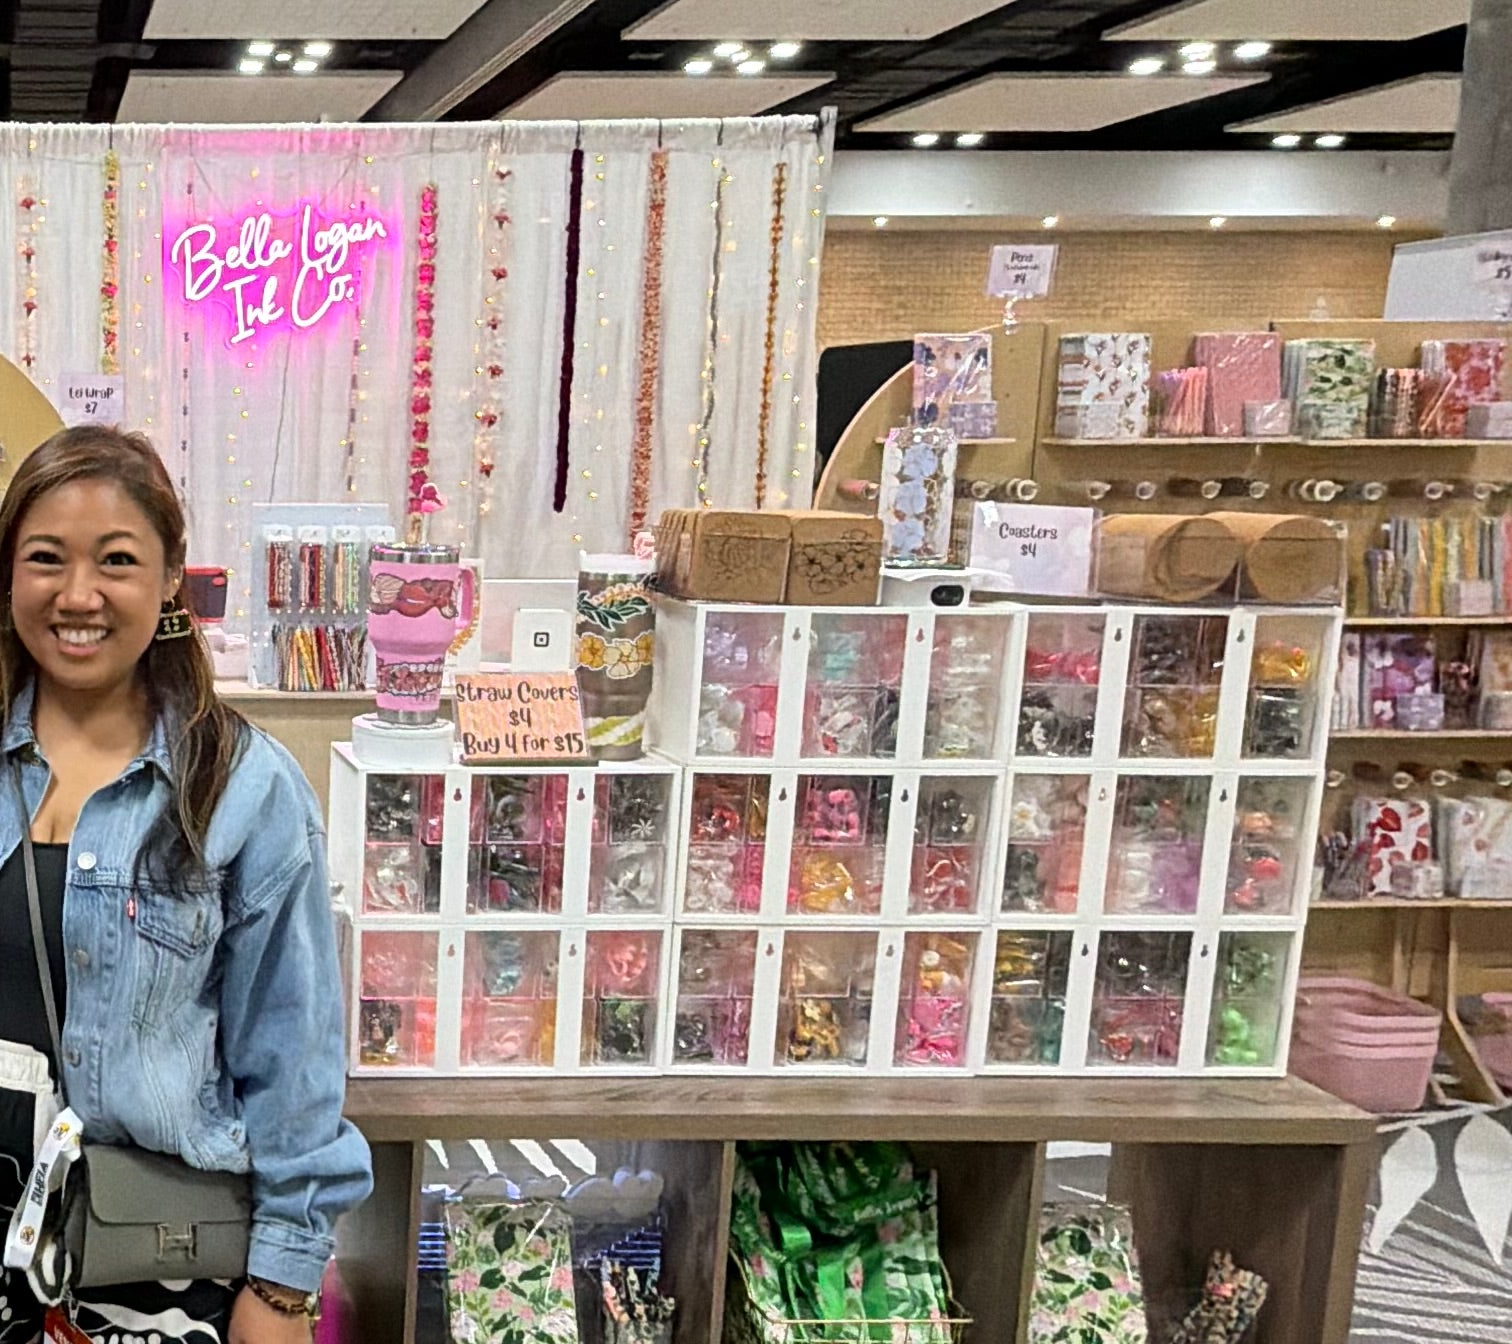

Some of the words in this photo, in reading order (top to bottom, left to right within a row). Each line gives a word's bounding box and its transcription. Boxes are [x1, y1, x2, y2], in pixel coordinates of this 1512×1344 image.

[171, 213, 293, 301] Bella
[301, 204, 387, 274] Logan
[223, 275, 285, 344] Ink
[291, 260, 355, 328] Co.
[999, 522, 1058, 540] Coasters
[1020, 543, 1037, 558] $4
[455, 682, 512, 703] Straw
[517, 681, 579, 704] Covers
[508, 708, 532, 728] $4
[462, 732, 501, 755] Buy
[505, 732, 517, 754] 4
[522, 733, 550, 753] for
[554, 732, 584, 754] $15
